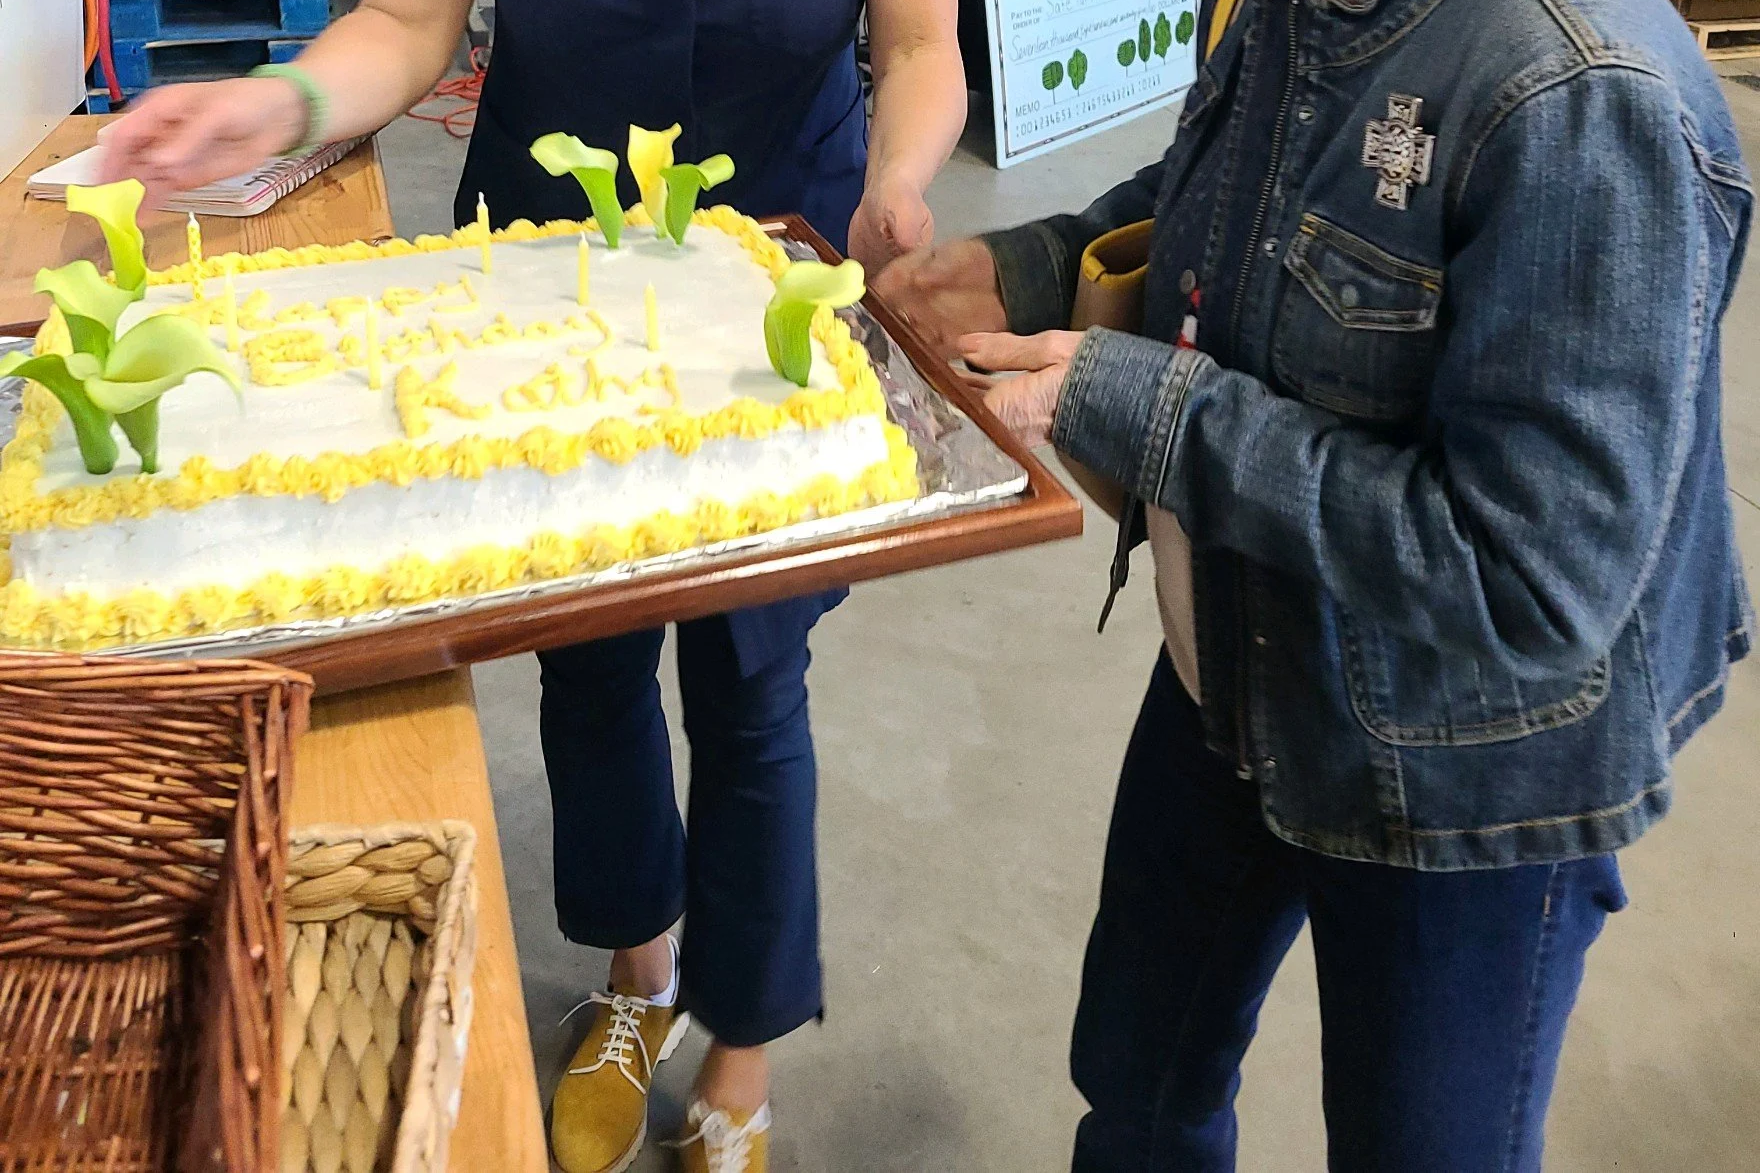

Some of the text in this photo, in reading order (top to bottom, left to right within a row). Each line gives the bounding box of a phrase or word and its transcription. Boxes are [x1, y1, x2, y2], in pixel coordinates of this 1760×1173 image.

[1015, 100, 1041, 118] MEMO
[243, 309, 614, 387] Birthday
[396, 357, 684, 438] Kathy
